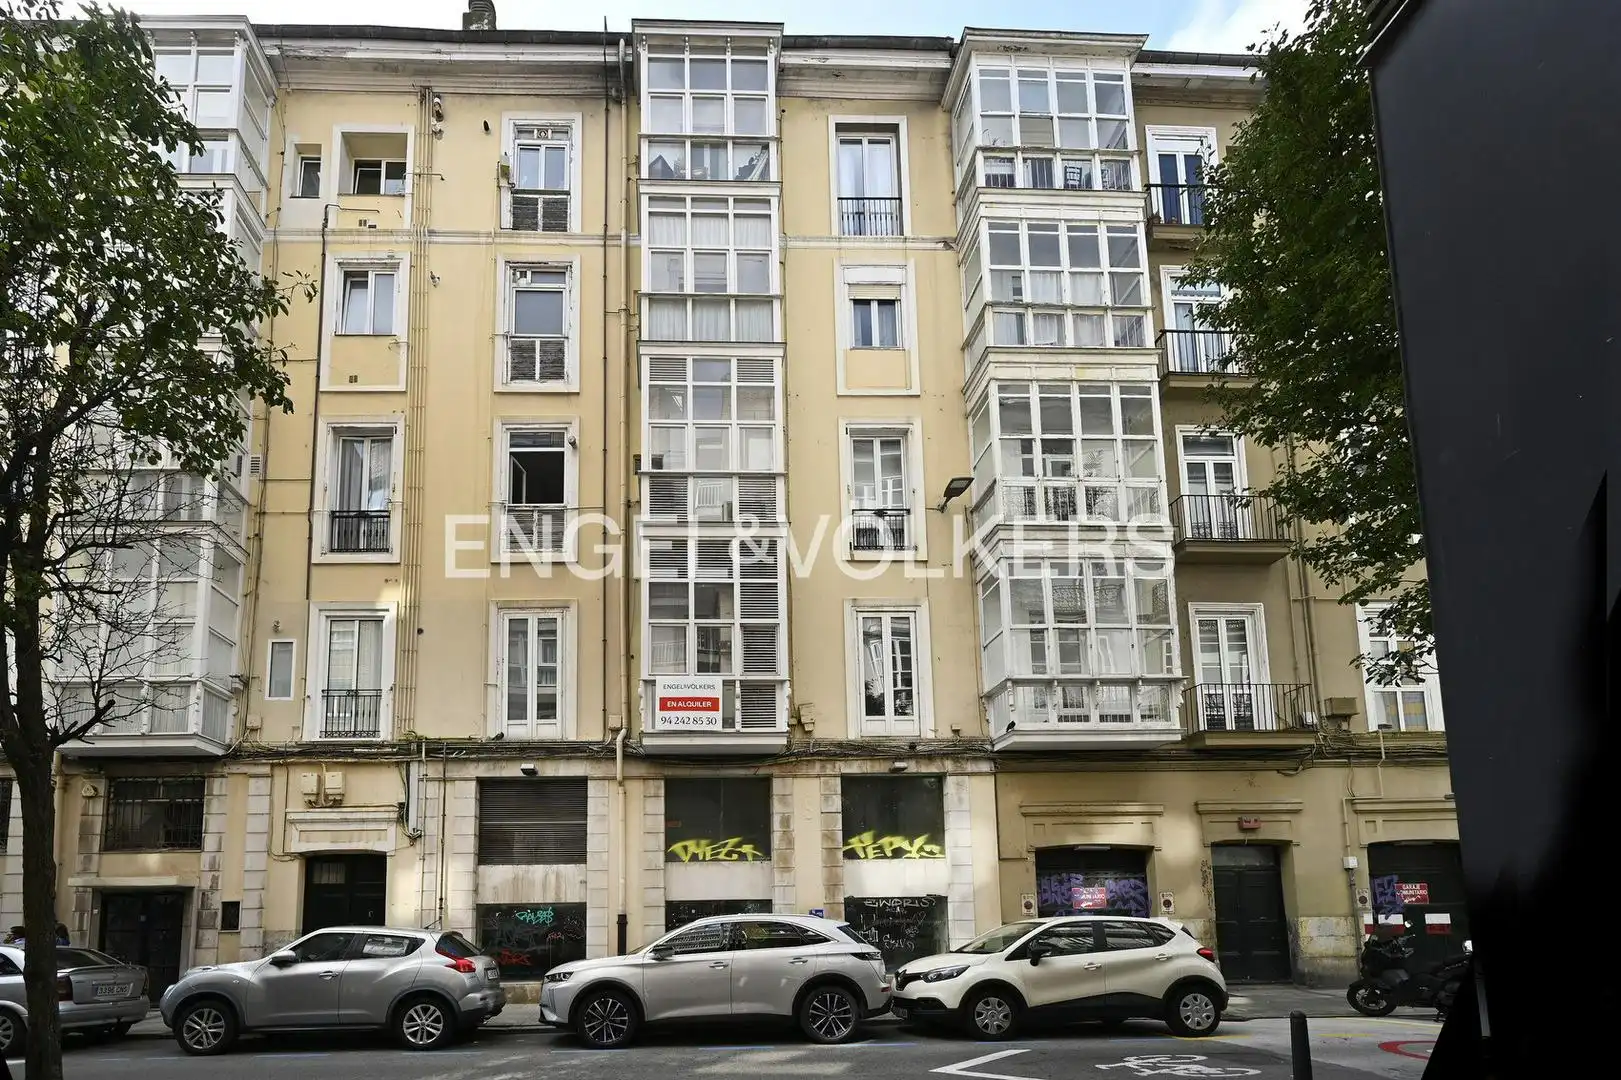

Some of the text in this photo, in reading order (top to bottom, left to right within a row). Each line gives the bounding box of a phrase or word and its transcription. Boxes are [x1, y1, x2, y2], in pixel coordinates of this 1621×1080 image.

[660, 716, 717, 725] 94 242 85 30
